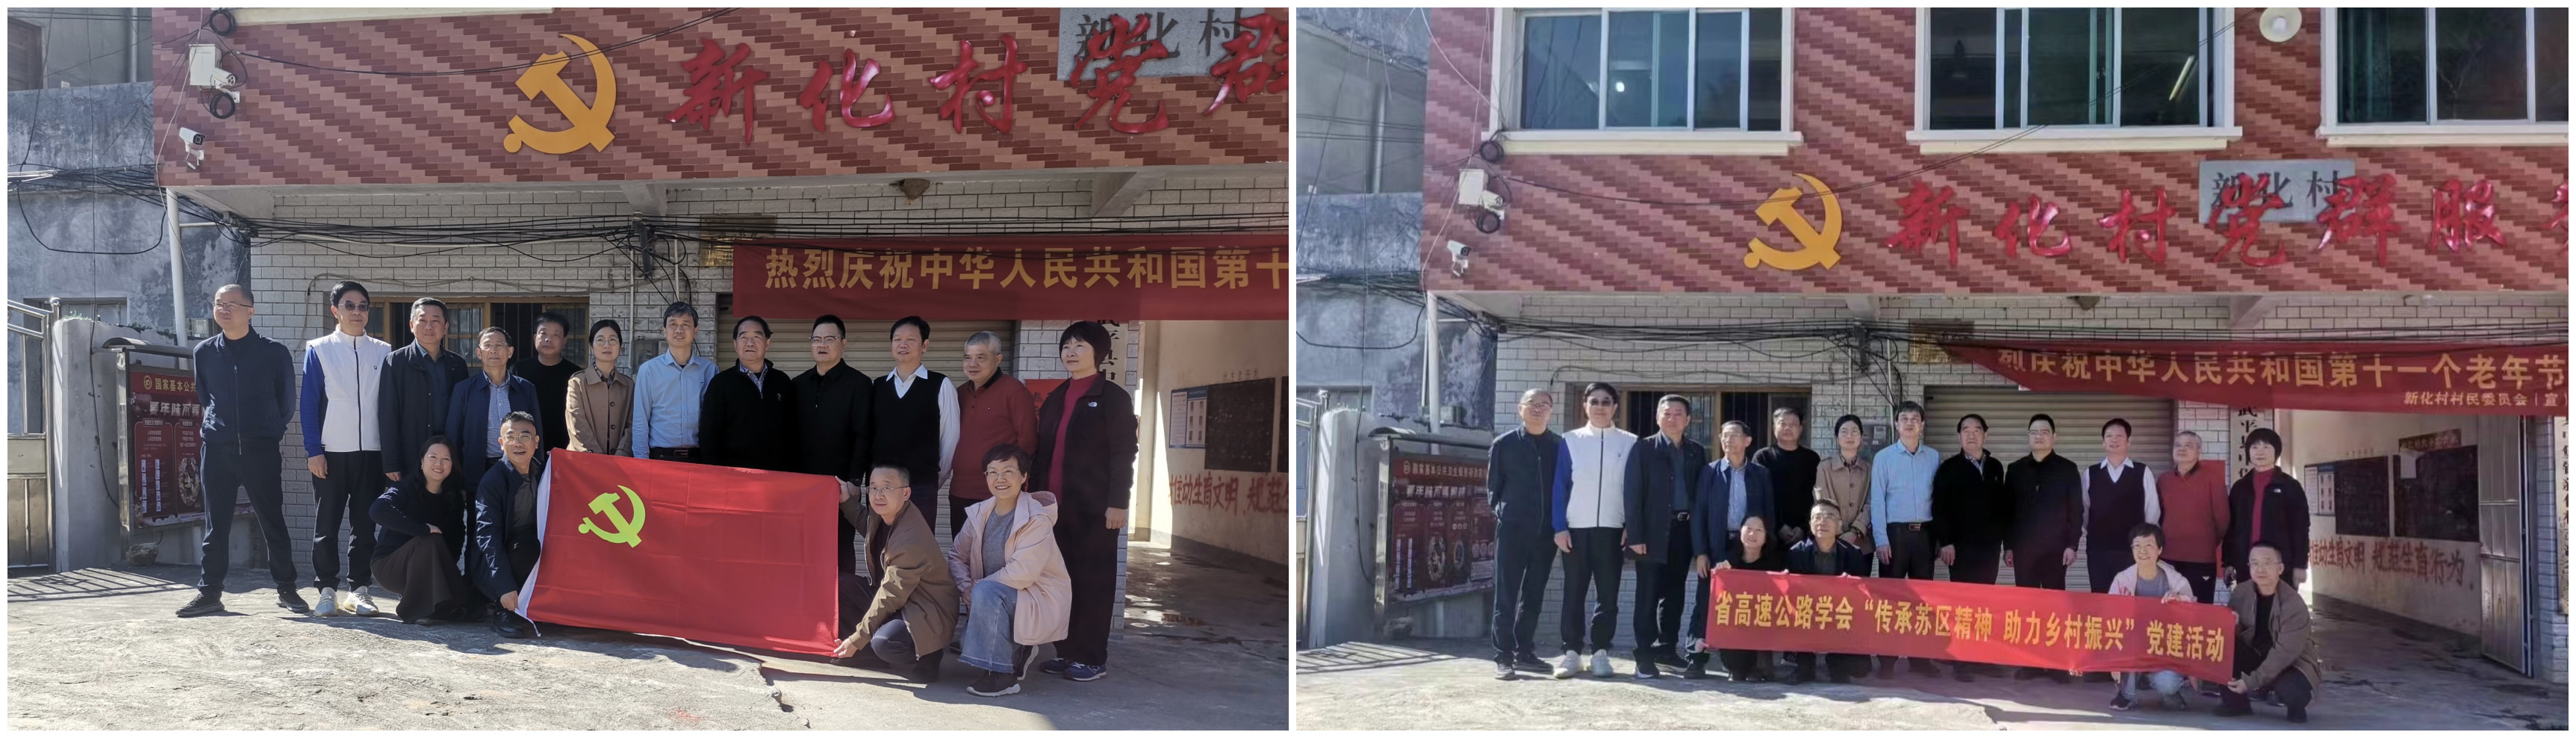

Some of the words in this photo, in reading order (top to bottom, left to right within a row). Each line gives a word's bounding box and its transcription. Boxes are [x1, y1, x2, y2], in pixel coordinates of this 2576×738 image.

[765, 246, 1289, 290] 热烈庆祝中华人民共和国第十
[149, 401, 205, 418] 要年味不要
